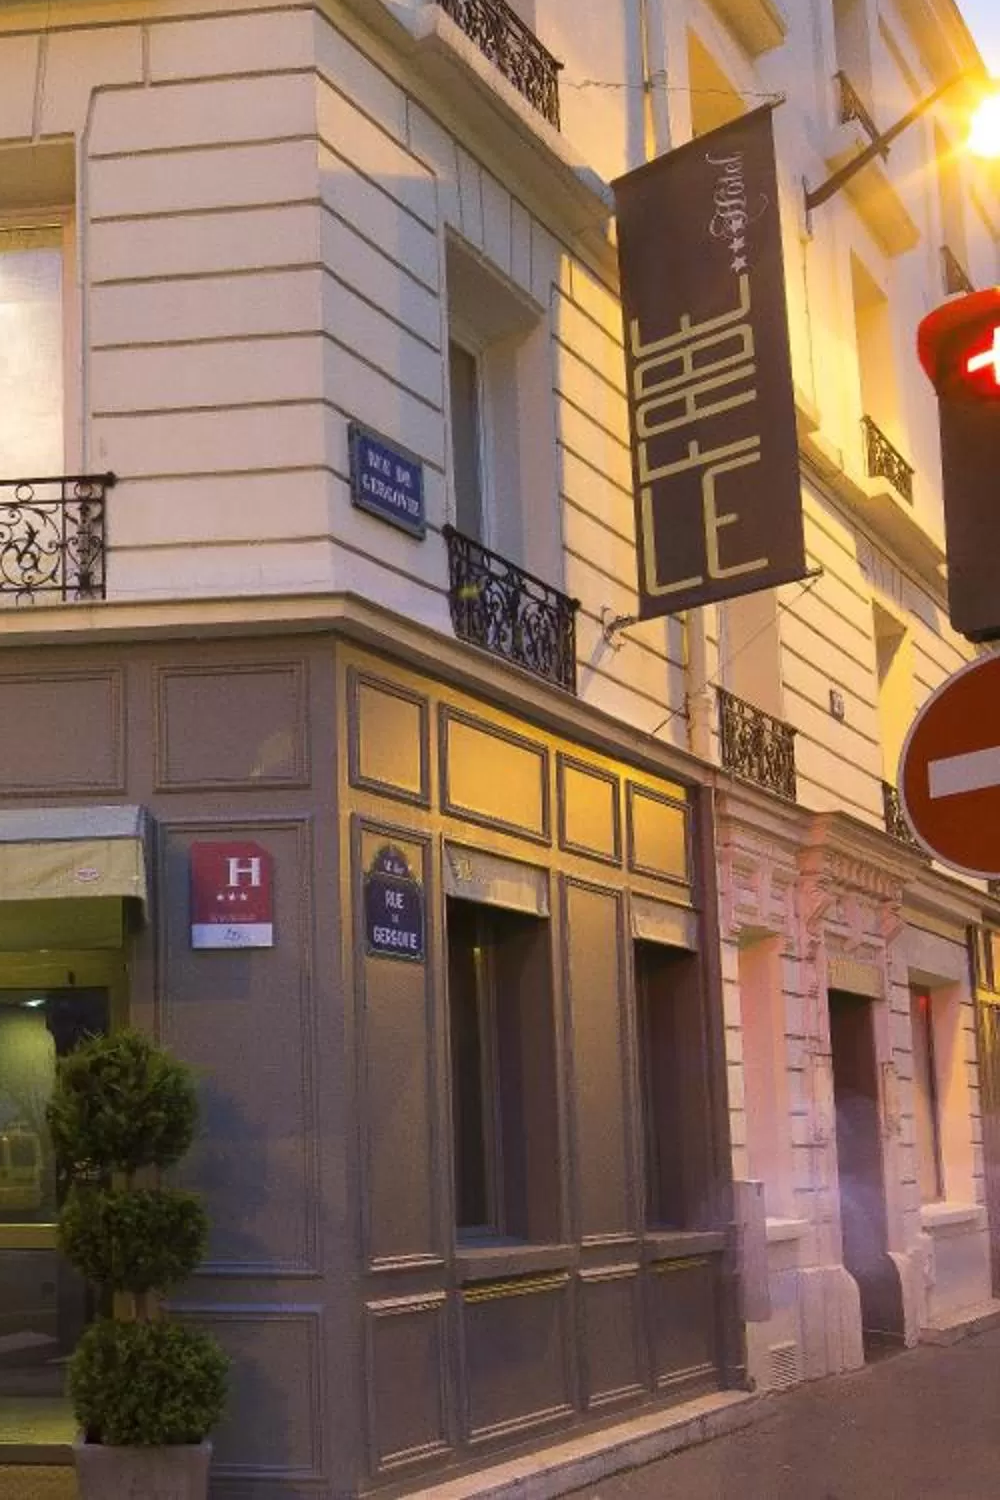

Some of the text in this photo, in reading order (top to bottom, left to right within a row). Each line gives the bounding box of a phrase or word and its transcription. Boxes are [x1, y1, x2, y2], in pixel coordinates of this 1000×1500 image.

[629, 273, 769, 597] LE FABE
[226, 856, 262, 888] H
[384, 889, 405, 910] RUE
